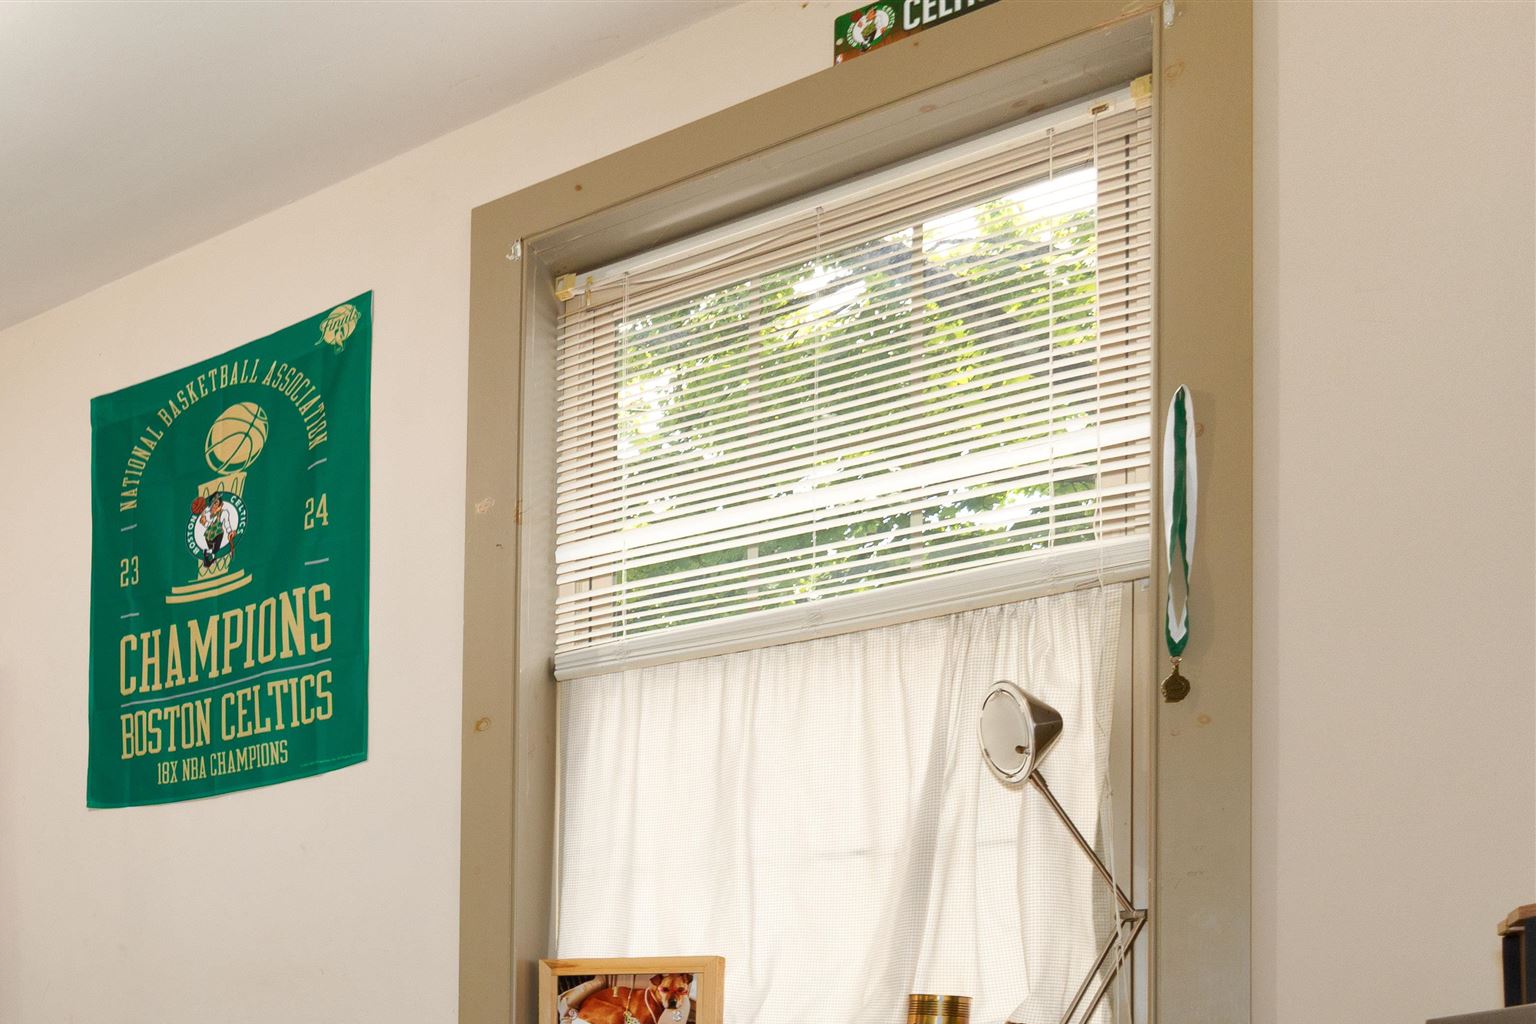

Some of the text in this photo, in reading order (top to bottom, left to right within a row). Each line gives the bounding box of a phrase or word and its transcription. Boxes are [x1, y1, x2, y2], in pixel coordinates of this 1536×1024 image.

[119, 358, 328, 512] NATIONAL BASKETBALL ASSOCIATION
[187, 495, 246, 555] BOSTON CELTICS
[304, 493, 328, 530] 24
[120, 555, 139, 588] 23
[120, 582, 332, 696] CHAMPIONS
[120, 669, 333, 760] BOSTON CELTICS
[157, 760, 178, 785] 18X
[182, 755, 207, 782] NBA
[210, 739, 289, 776] CHAMPIONS
